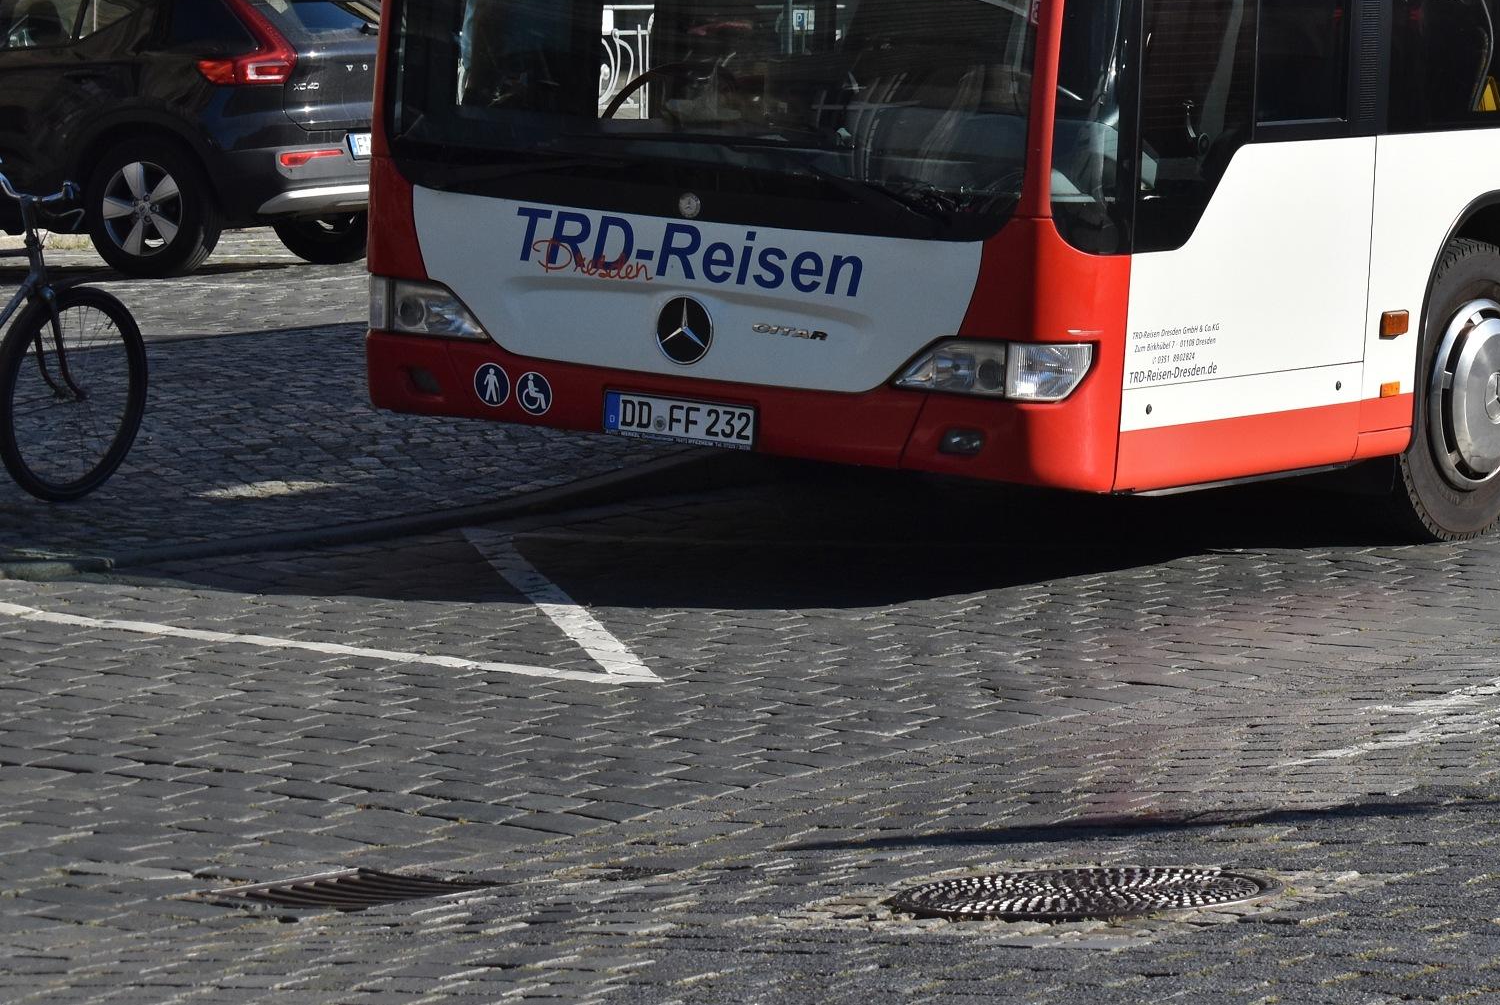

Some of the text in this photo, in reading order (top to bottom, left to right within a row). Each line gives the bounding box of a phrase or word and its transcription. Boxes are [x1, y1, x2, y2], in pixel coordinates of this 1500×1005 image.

[293, 82, 320, 91] XC40
[515, 207, 863, 297] TRD-Reisen
[532, 237, 654, 282] Dresden
[1129, 362, 1218, 384] TRD-Reisen-Dresden.de
[620, 399, 751, 441] DD FF 232
